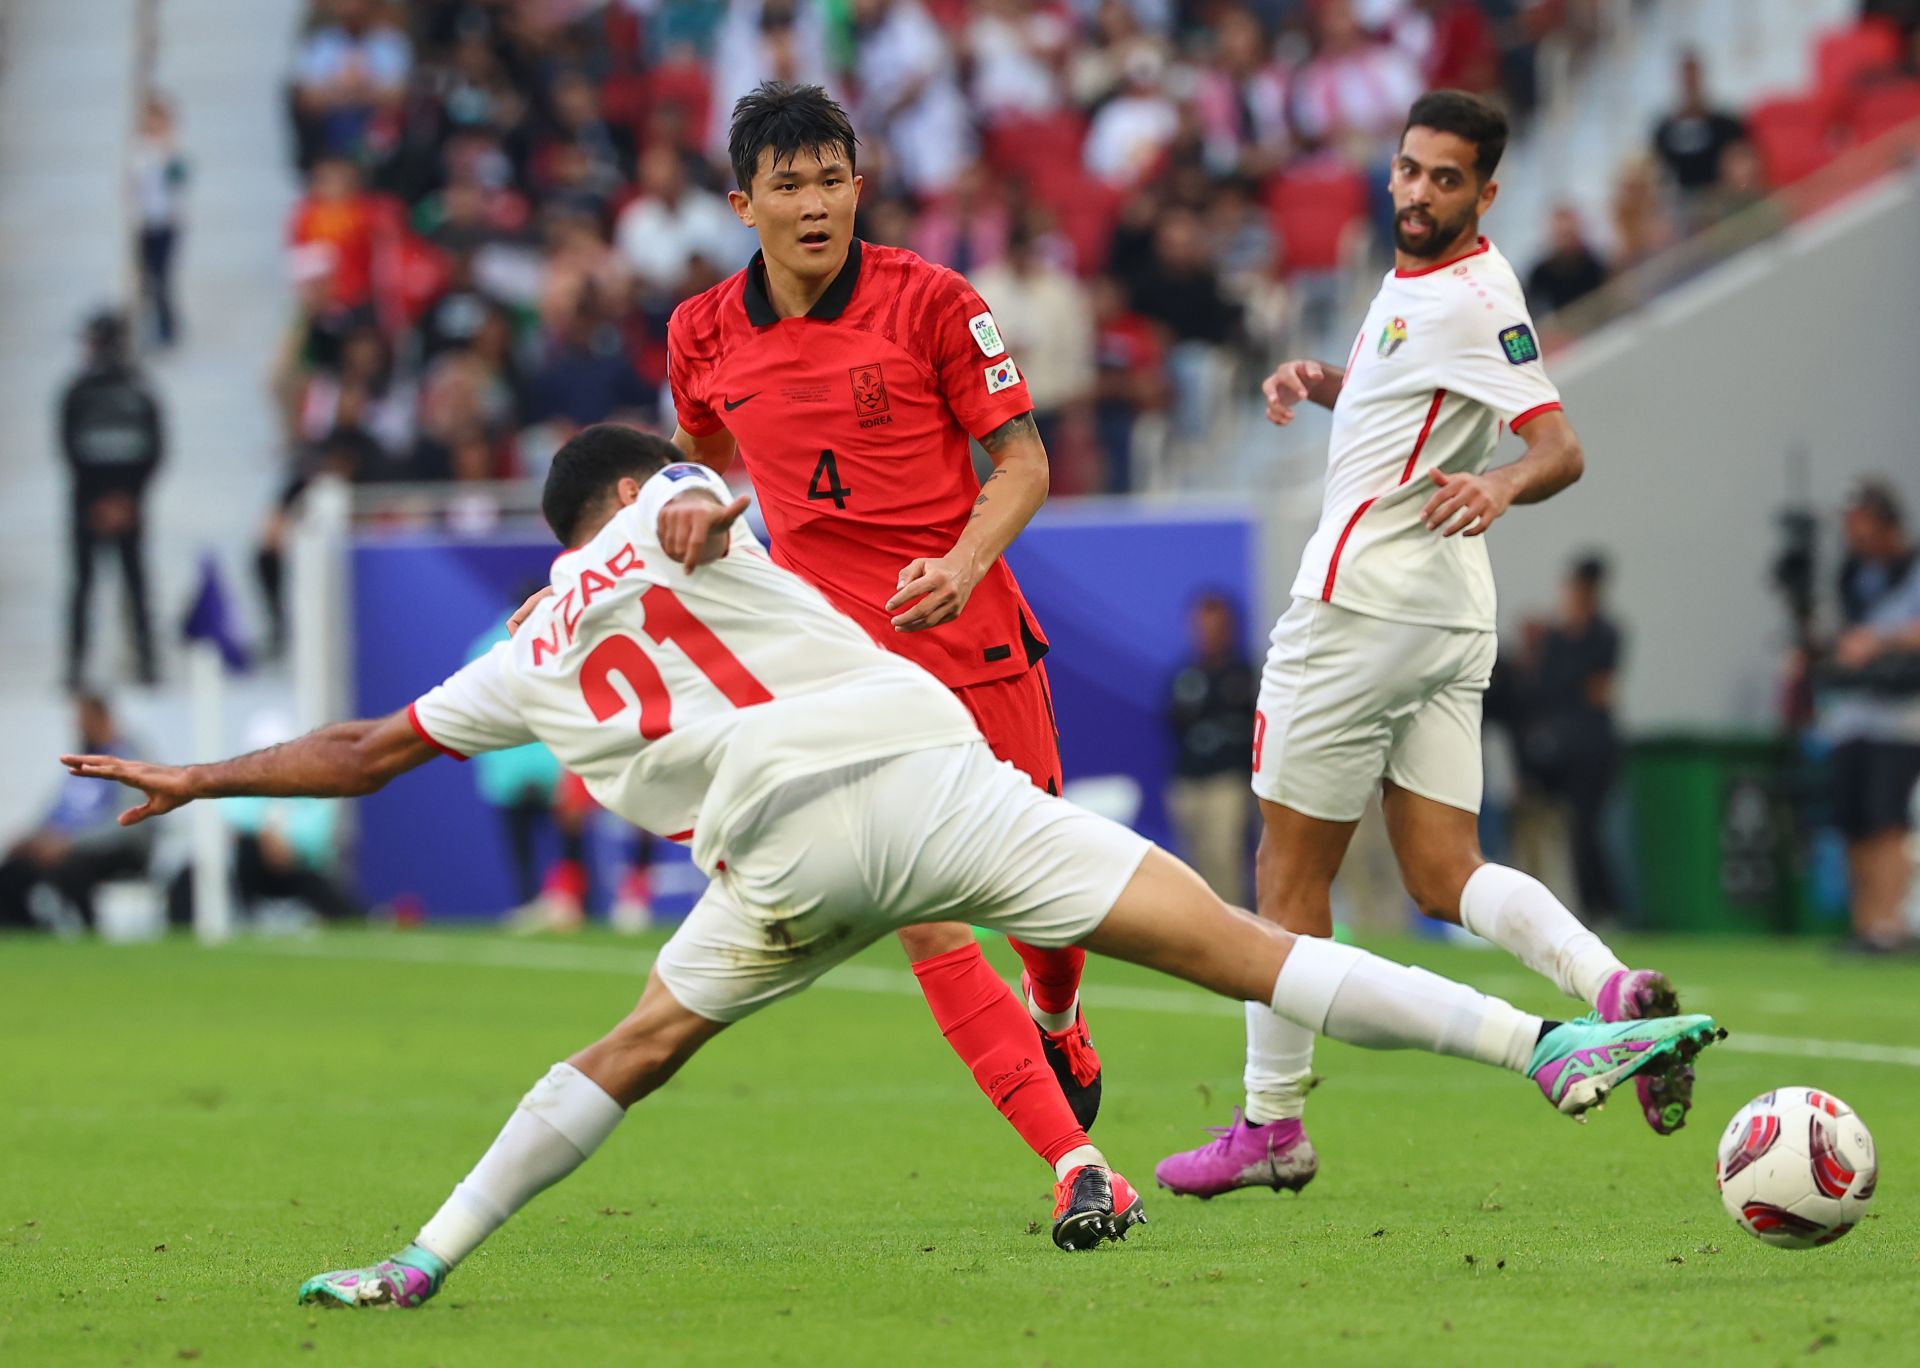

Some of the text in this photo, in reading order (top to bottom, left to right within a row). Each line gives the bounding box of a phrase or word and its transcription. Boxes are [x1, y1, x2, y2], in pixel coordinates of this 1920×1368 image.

[975, 320, 986, 330] AFC
[859, 415, 893, 429] KOREA
[807, 449, 851, 510] 4
[579, 583, 775, 741] 21
